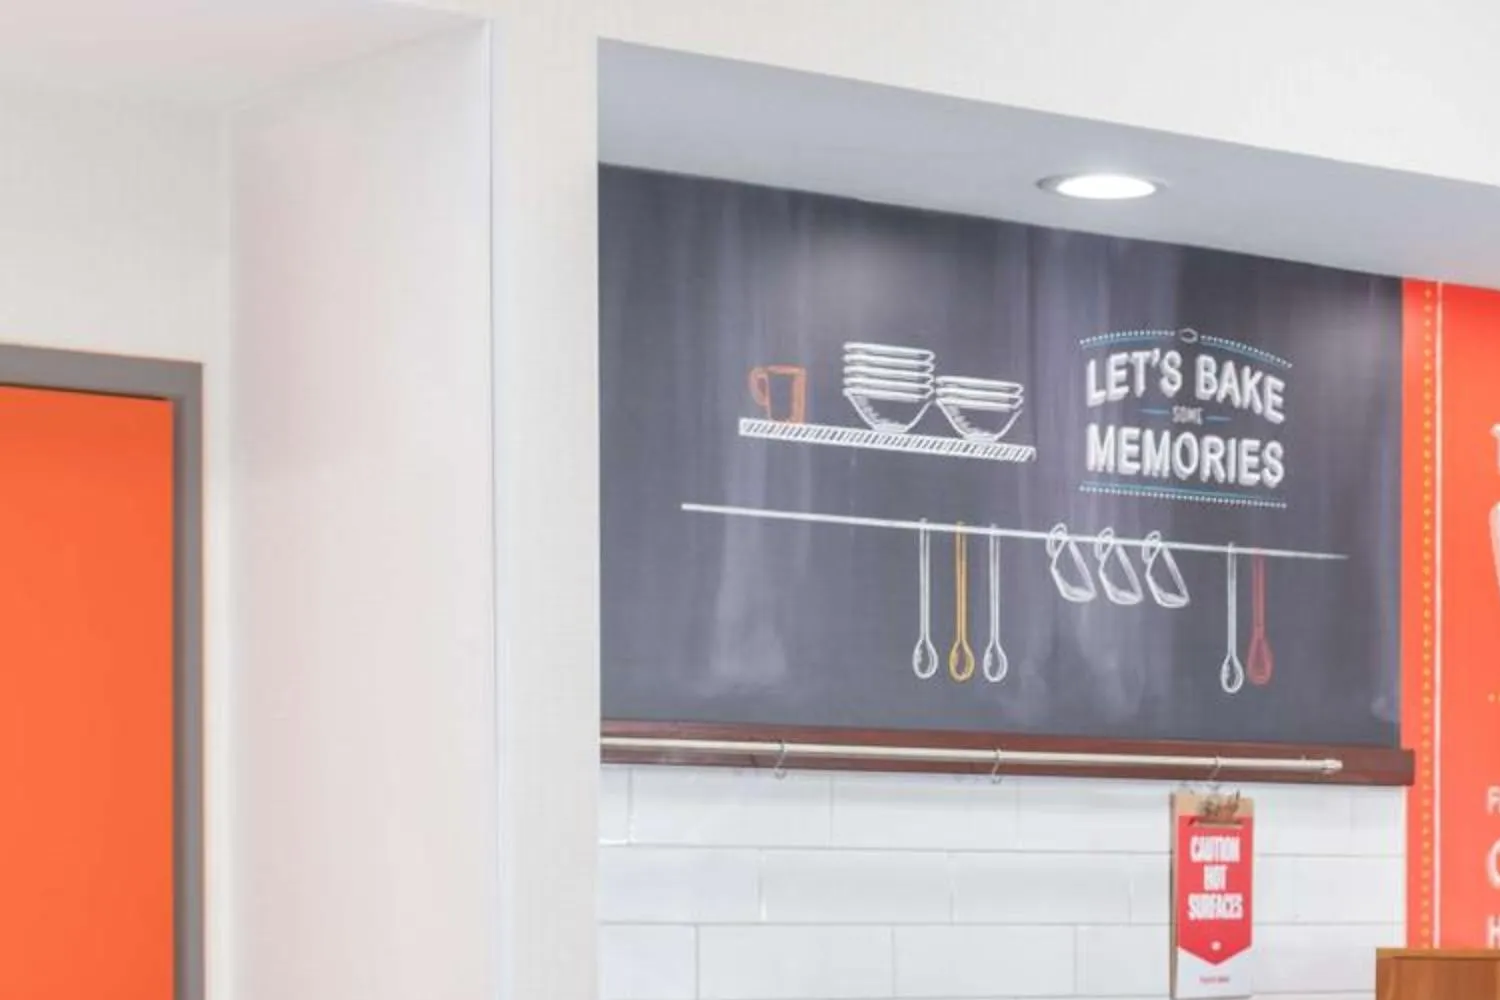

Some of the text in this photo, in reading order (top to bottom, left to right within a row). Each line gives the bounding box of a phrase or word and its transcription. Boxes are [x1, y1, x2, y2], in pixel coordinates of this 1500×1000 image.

[1086, 348, 1286, 424] LET'S BAKE
[1086, 423, 1286, 489] MEMORIES
